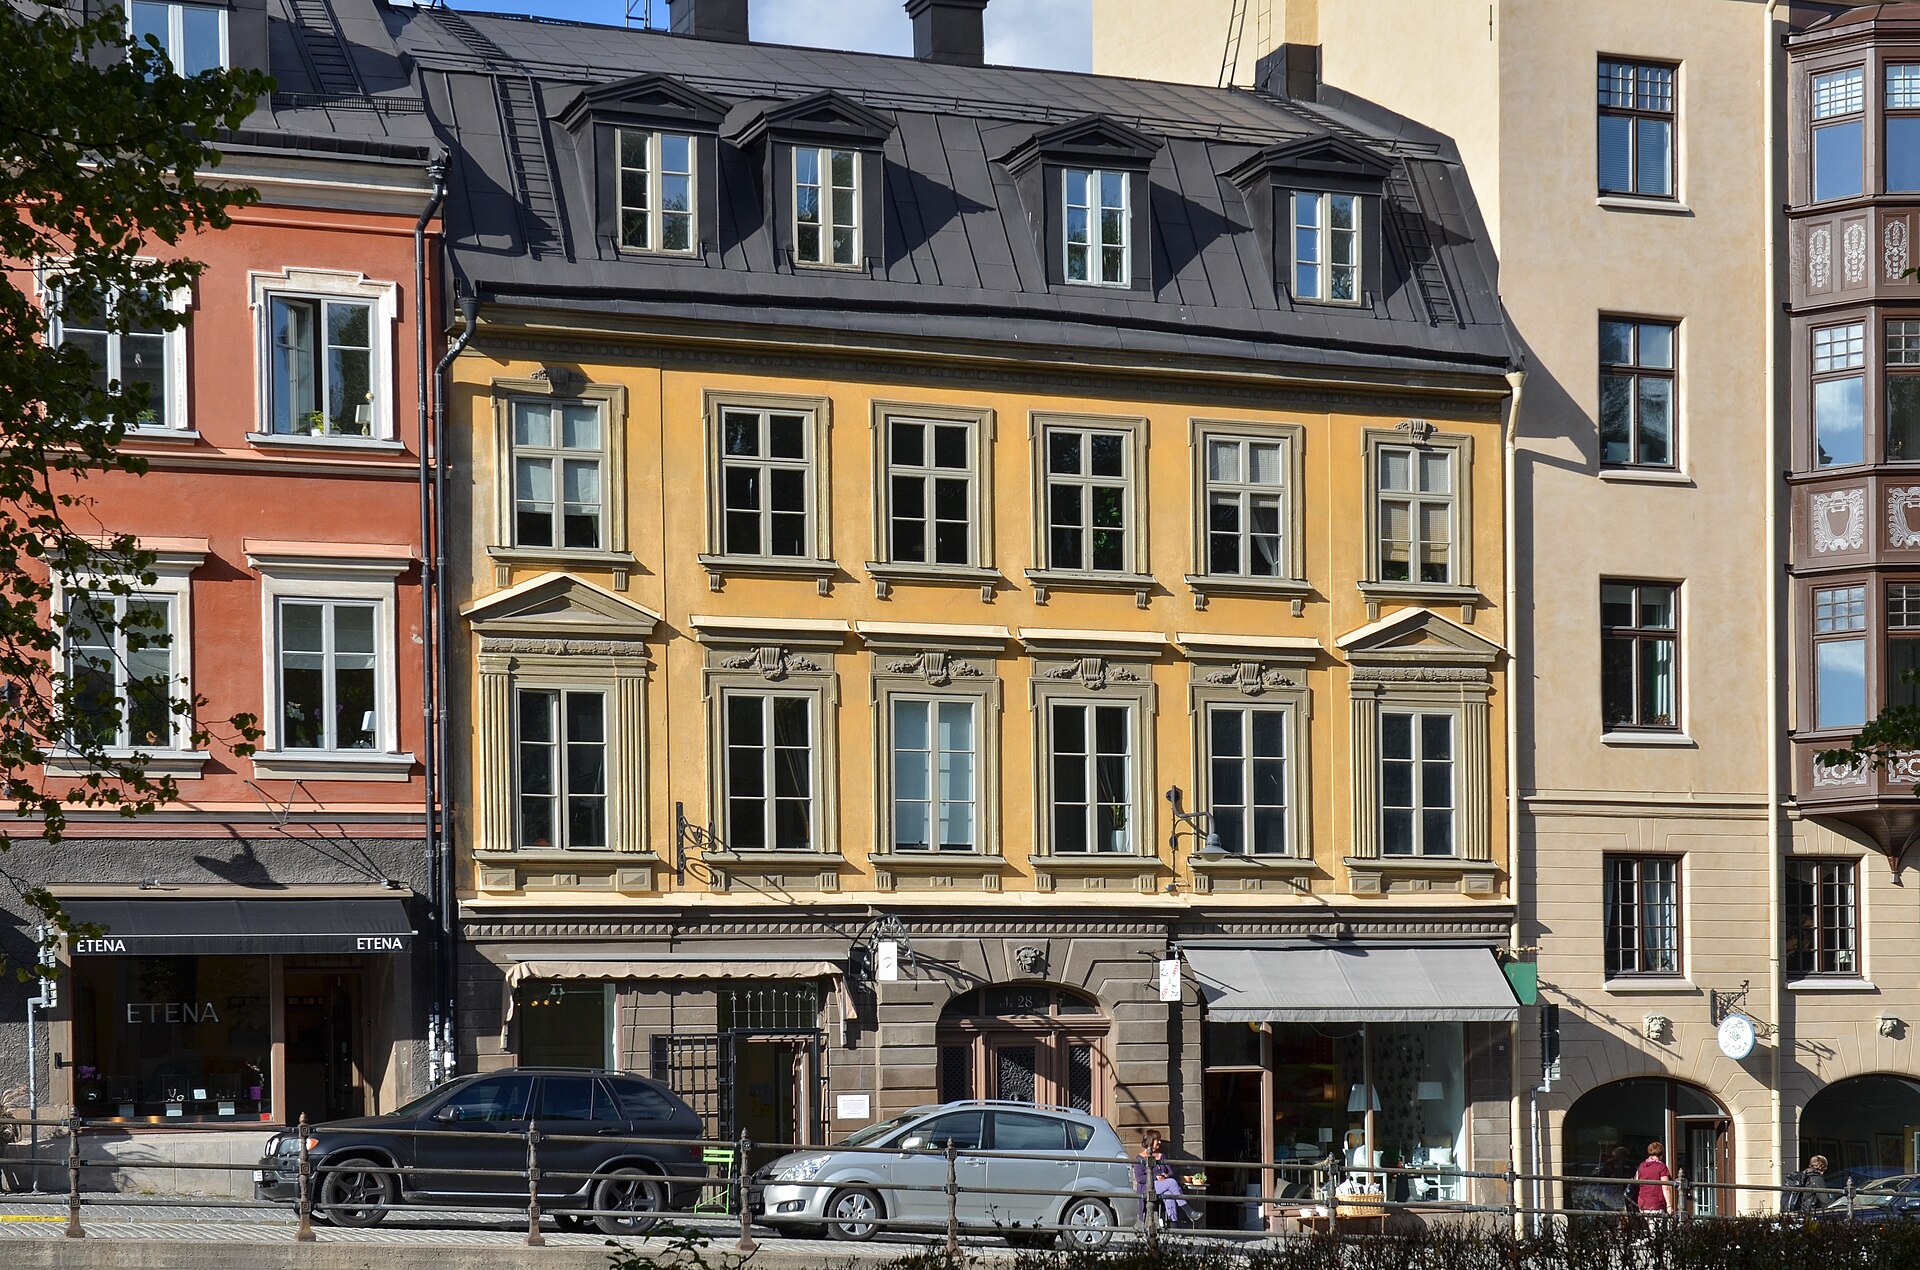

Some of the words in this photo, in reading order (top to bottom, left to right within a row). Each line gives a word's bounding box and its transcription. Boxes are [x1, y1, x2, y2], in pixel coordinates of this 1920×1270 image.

[77, 939, 126, 952] ETENA
[357, 937, 403, 950] ETENA
[1017, 995, 1033, 1008] 28
[127, 1002, 219, 1023] ETENA
